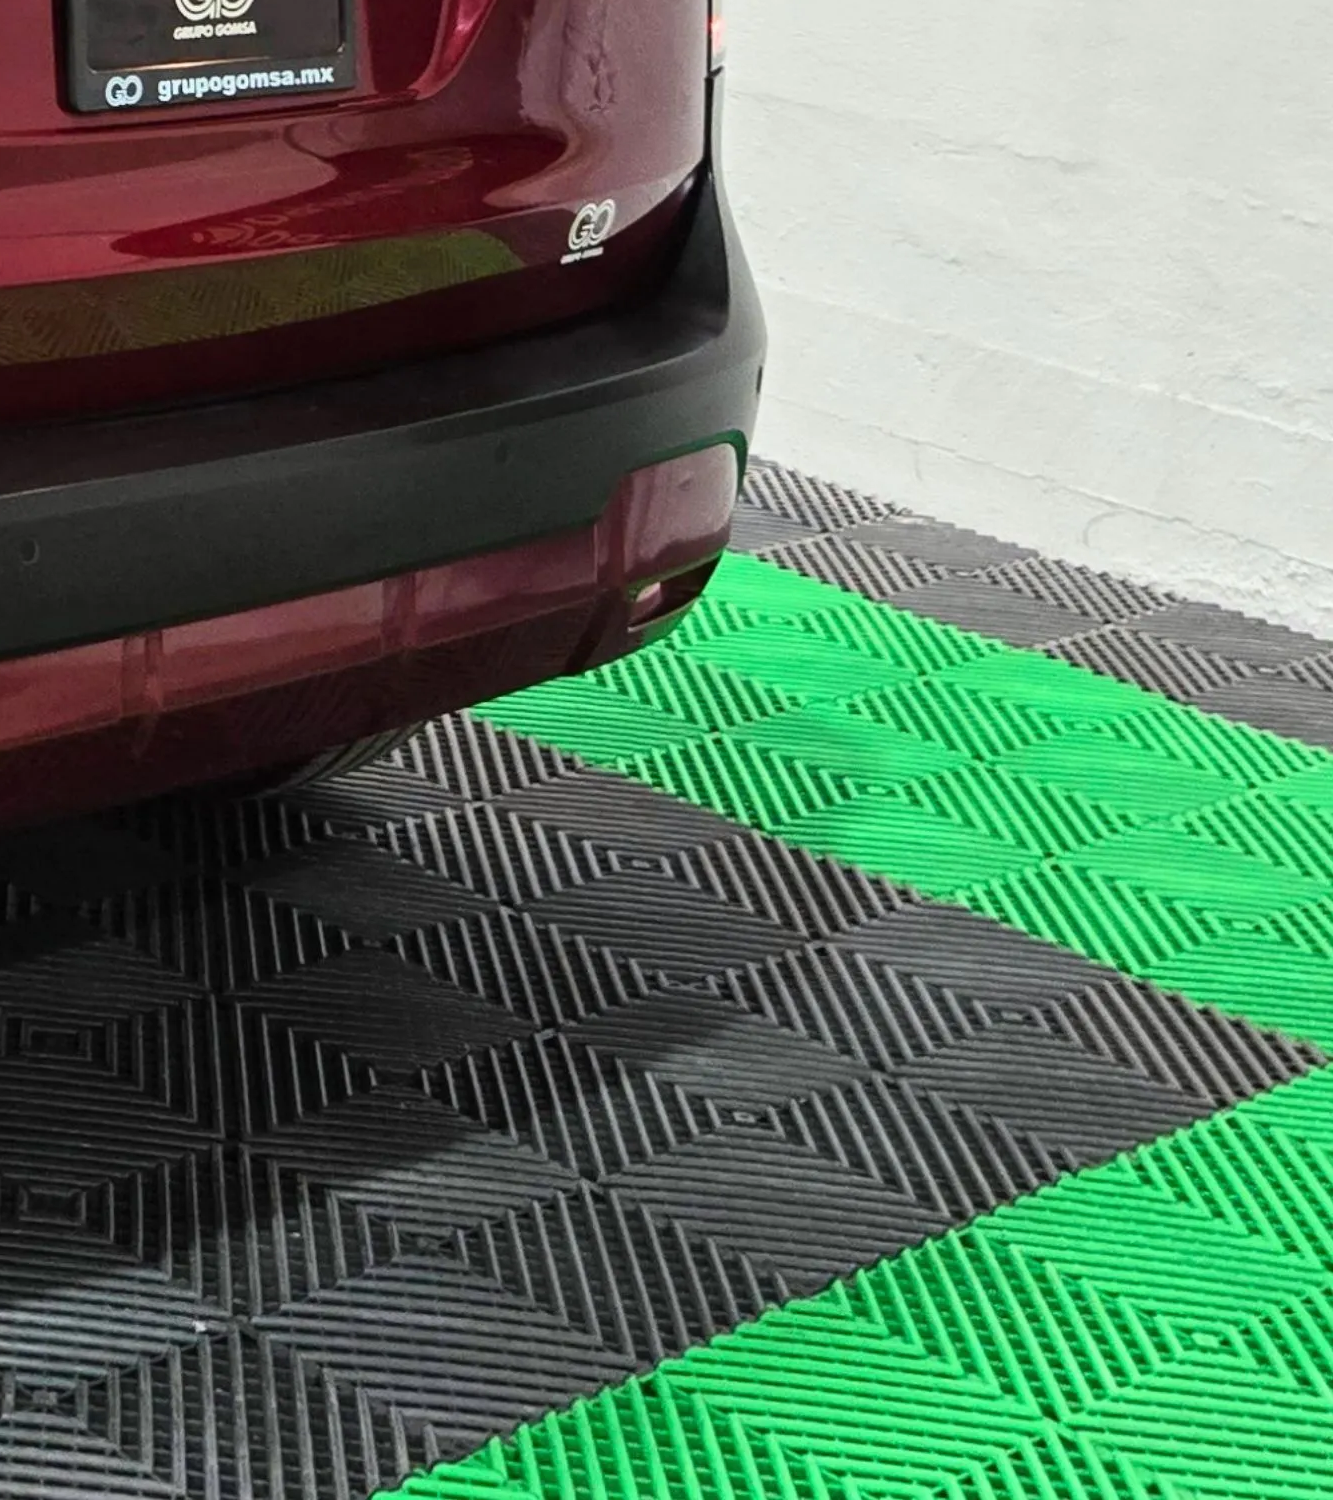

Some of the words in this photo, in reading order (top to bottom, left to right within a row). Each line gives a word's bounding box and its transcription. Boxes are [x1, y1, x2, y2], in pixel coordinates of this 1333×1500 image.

[173, 24, 214, 40] GRUPO
[215, 20, 257, 37] GOMSA
[157, 66, 335, 103] grupogomsa.mx
